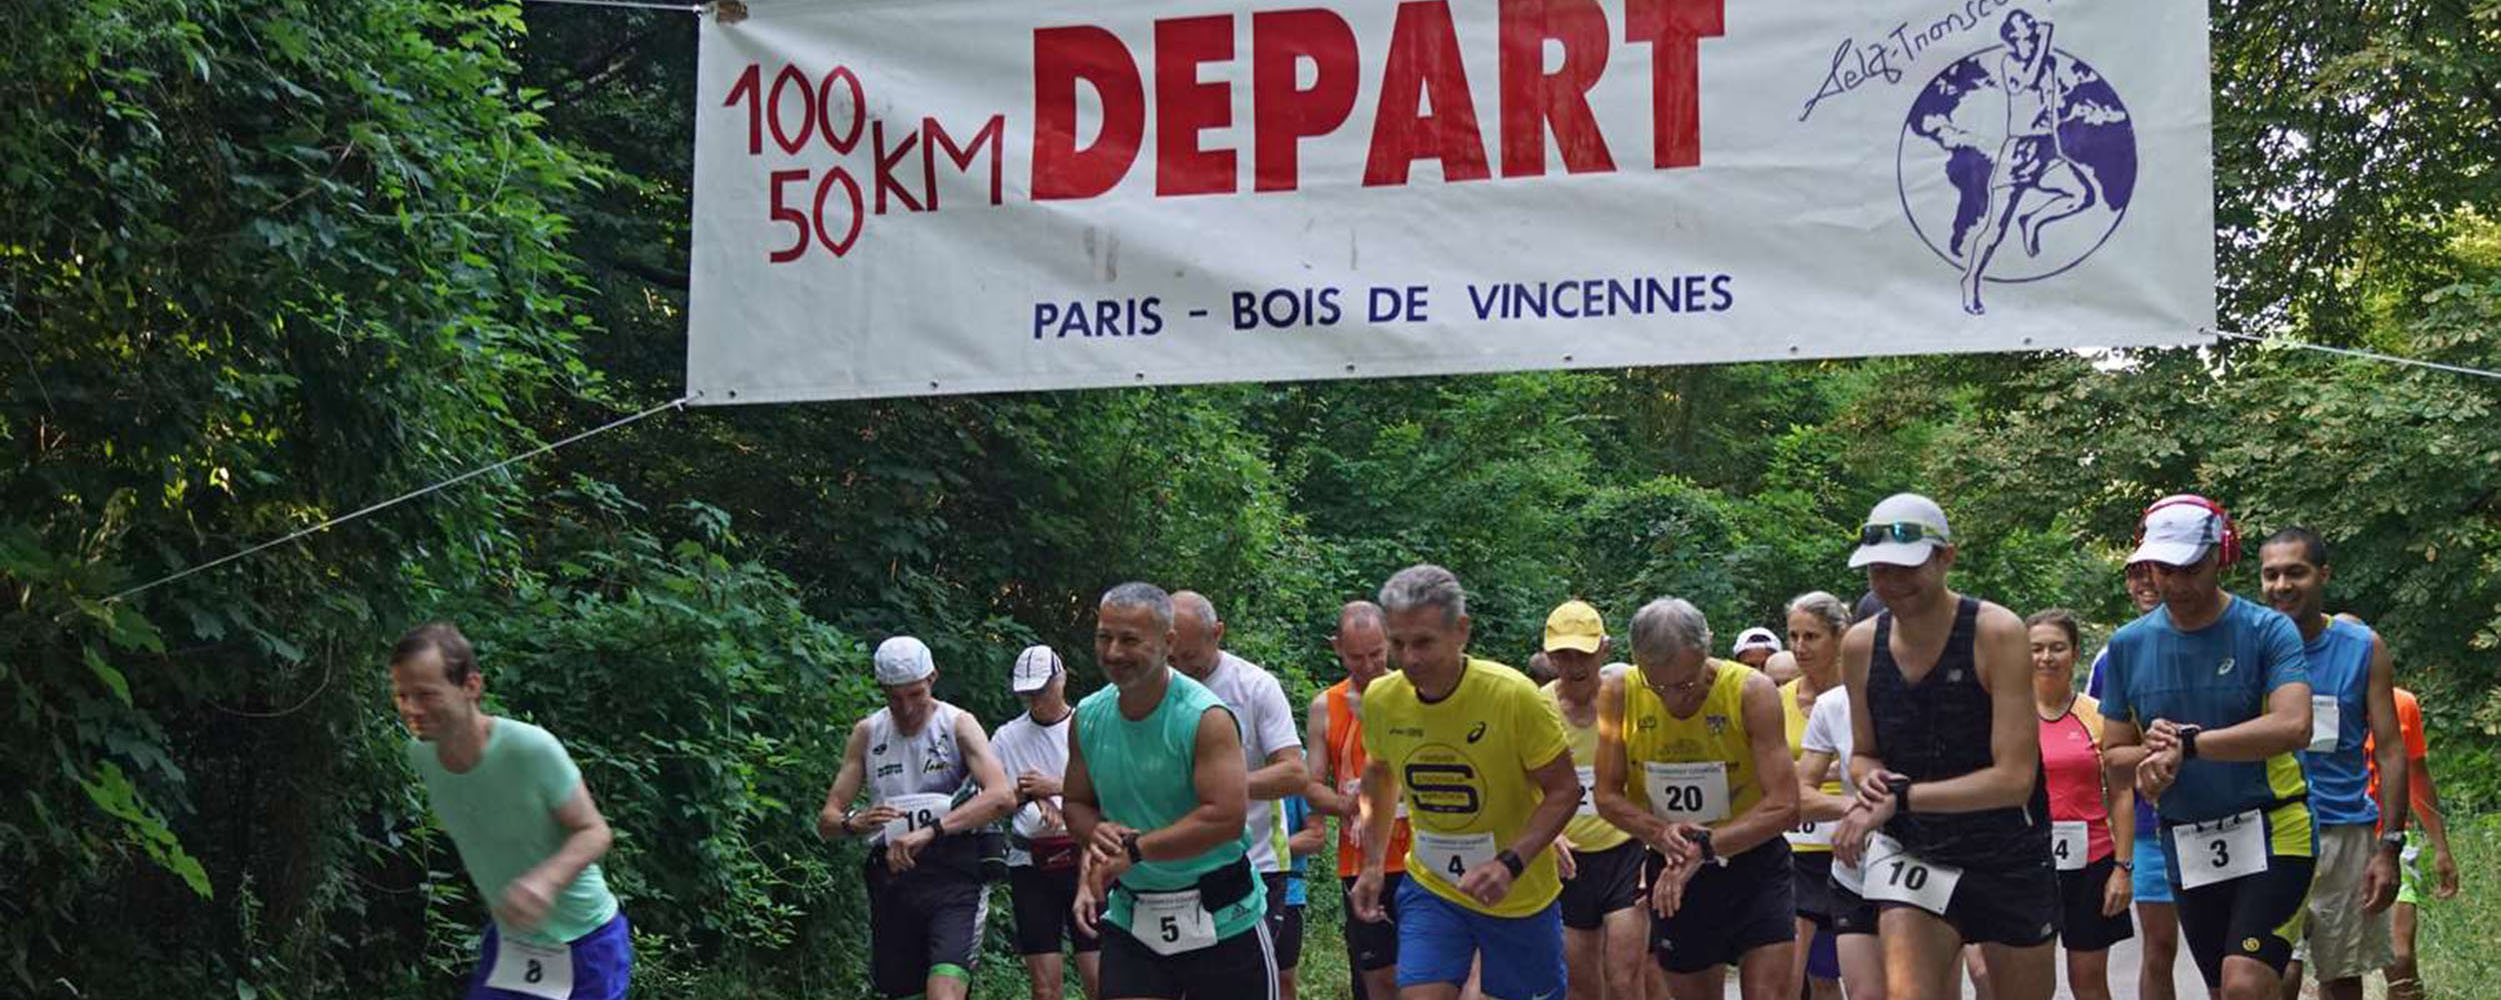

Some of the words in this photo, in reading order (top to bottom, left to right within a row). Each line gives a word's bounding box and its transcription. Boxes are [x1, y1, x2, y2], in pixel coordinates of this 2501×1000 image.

[723, 64, 866, 155] 100
[1031, 0, 1725, 200] DEPART
[873, 114, 1005, 215] KM
[770, 166, 863, 263] 50
[1033, 297, 1163, 339] PARIS
[1233, 287, 1341, 330] BOIS
[1368, 285, 1428, 324] DE
[1467, 273, 1734, 321] VINCENNES
[1664, 785, 1703, 812] 20
[1447, 854, 1465, 877] 4
[2210, 839, 2230, 868] 3
[1887, 859, 1928, 891] 10
[1160, 915, 1179, 943] 5
[525, 958, 543, 984] 8
